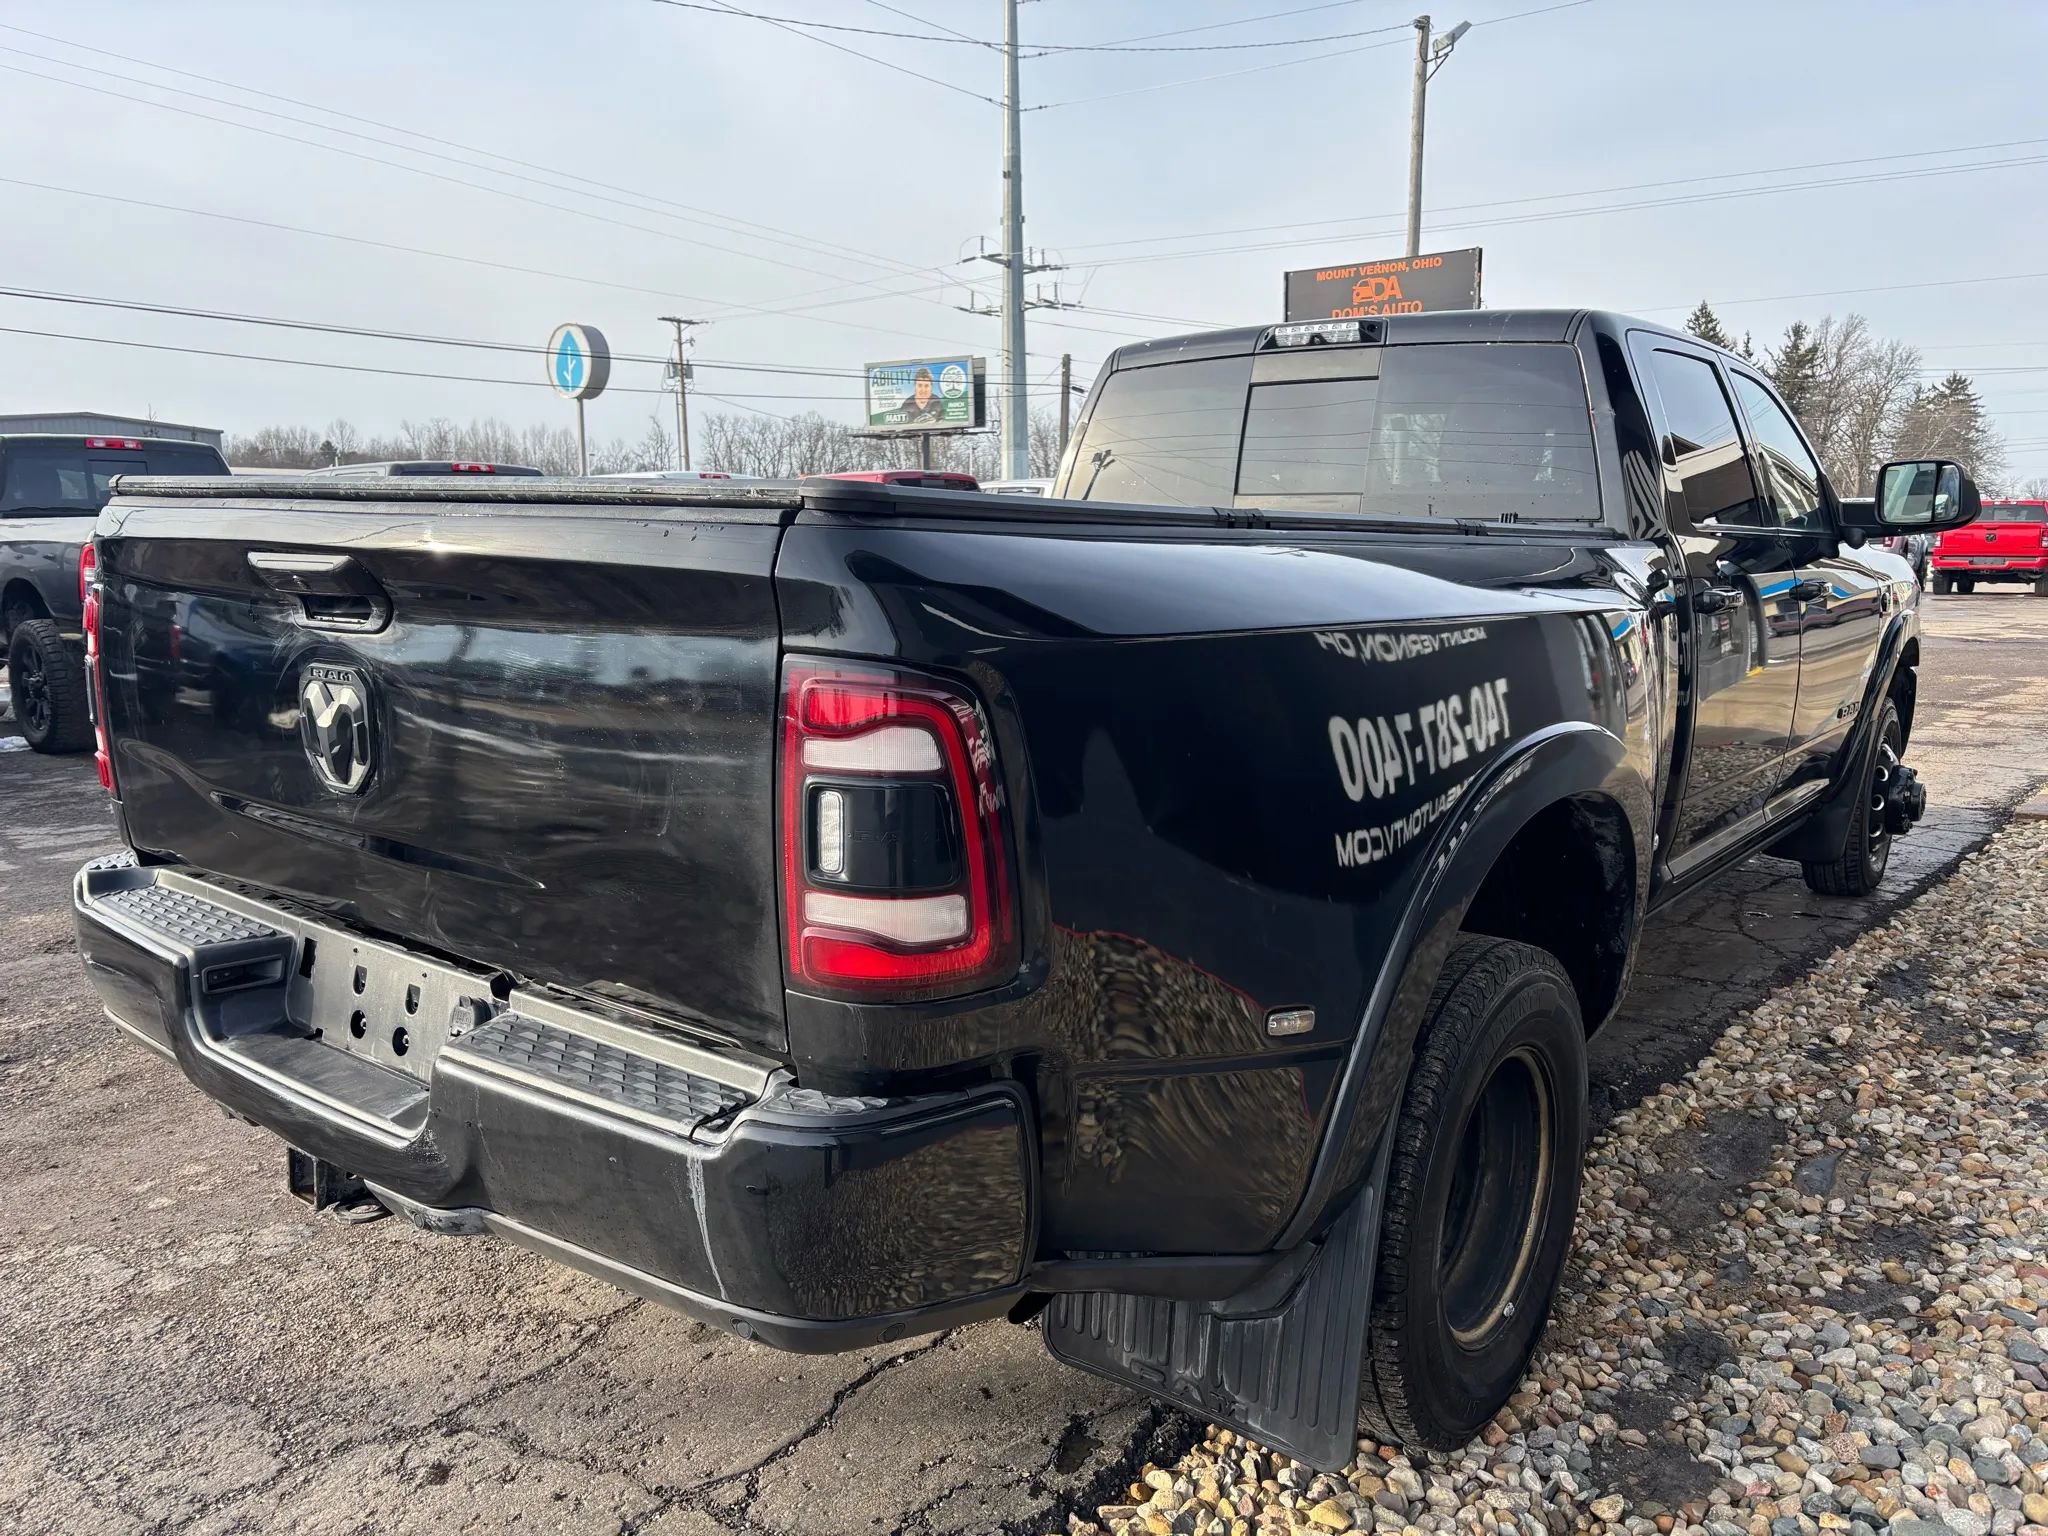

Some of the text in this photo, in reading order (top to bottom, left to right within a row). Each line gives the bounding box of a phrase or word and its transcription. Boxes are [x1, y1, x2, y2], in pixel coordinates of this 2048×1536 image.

[1316, 256, 1443, 282] MOUNT VERNON, OHIO
[1331, 300, 1423, 319] DOM'S AUTO
[310, 667, 352, 682] RAM
